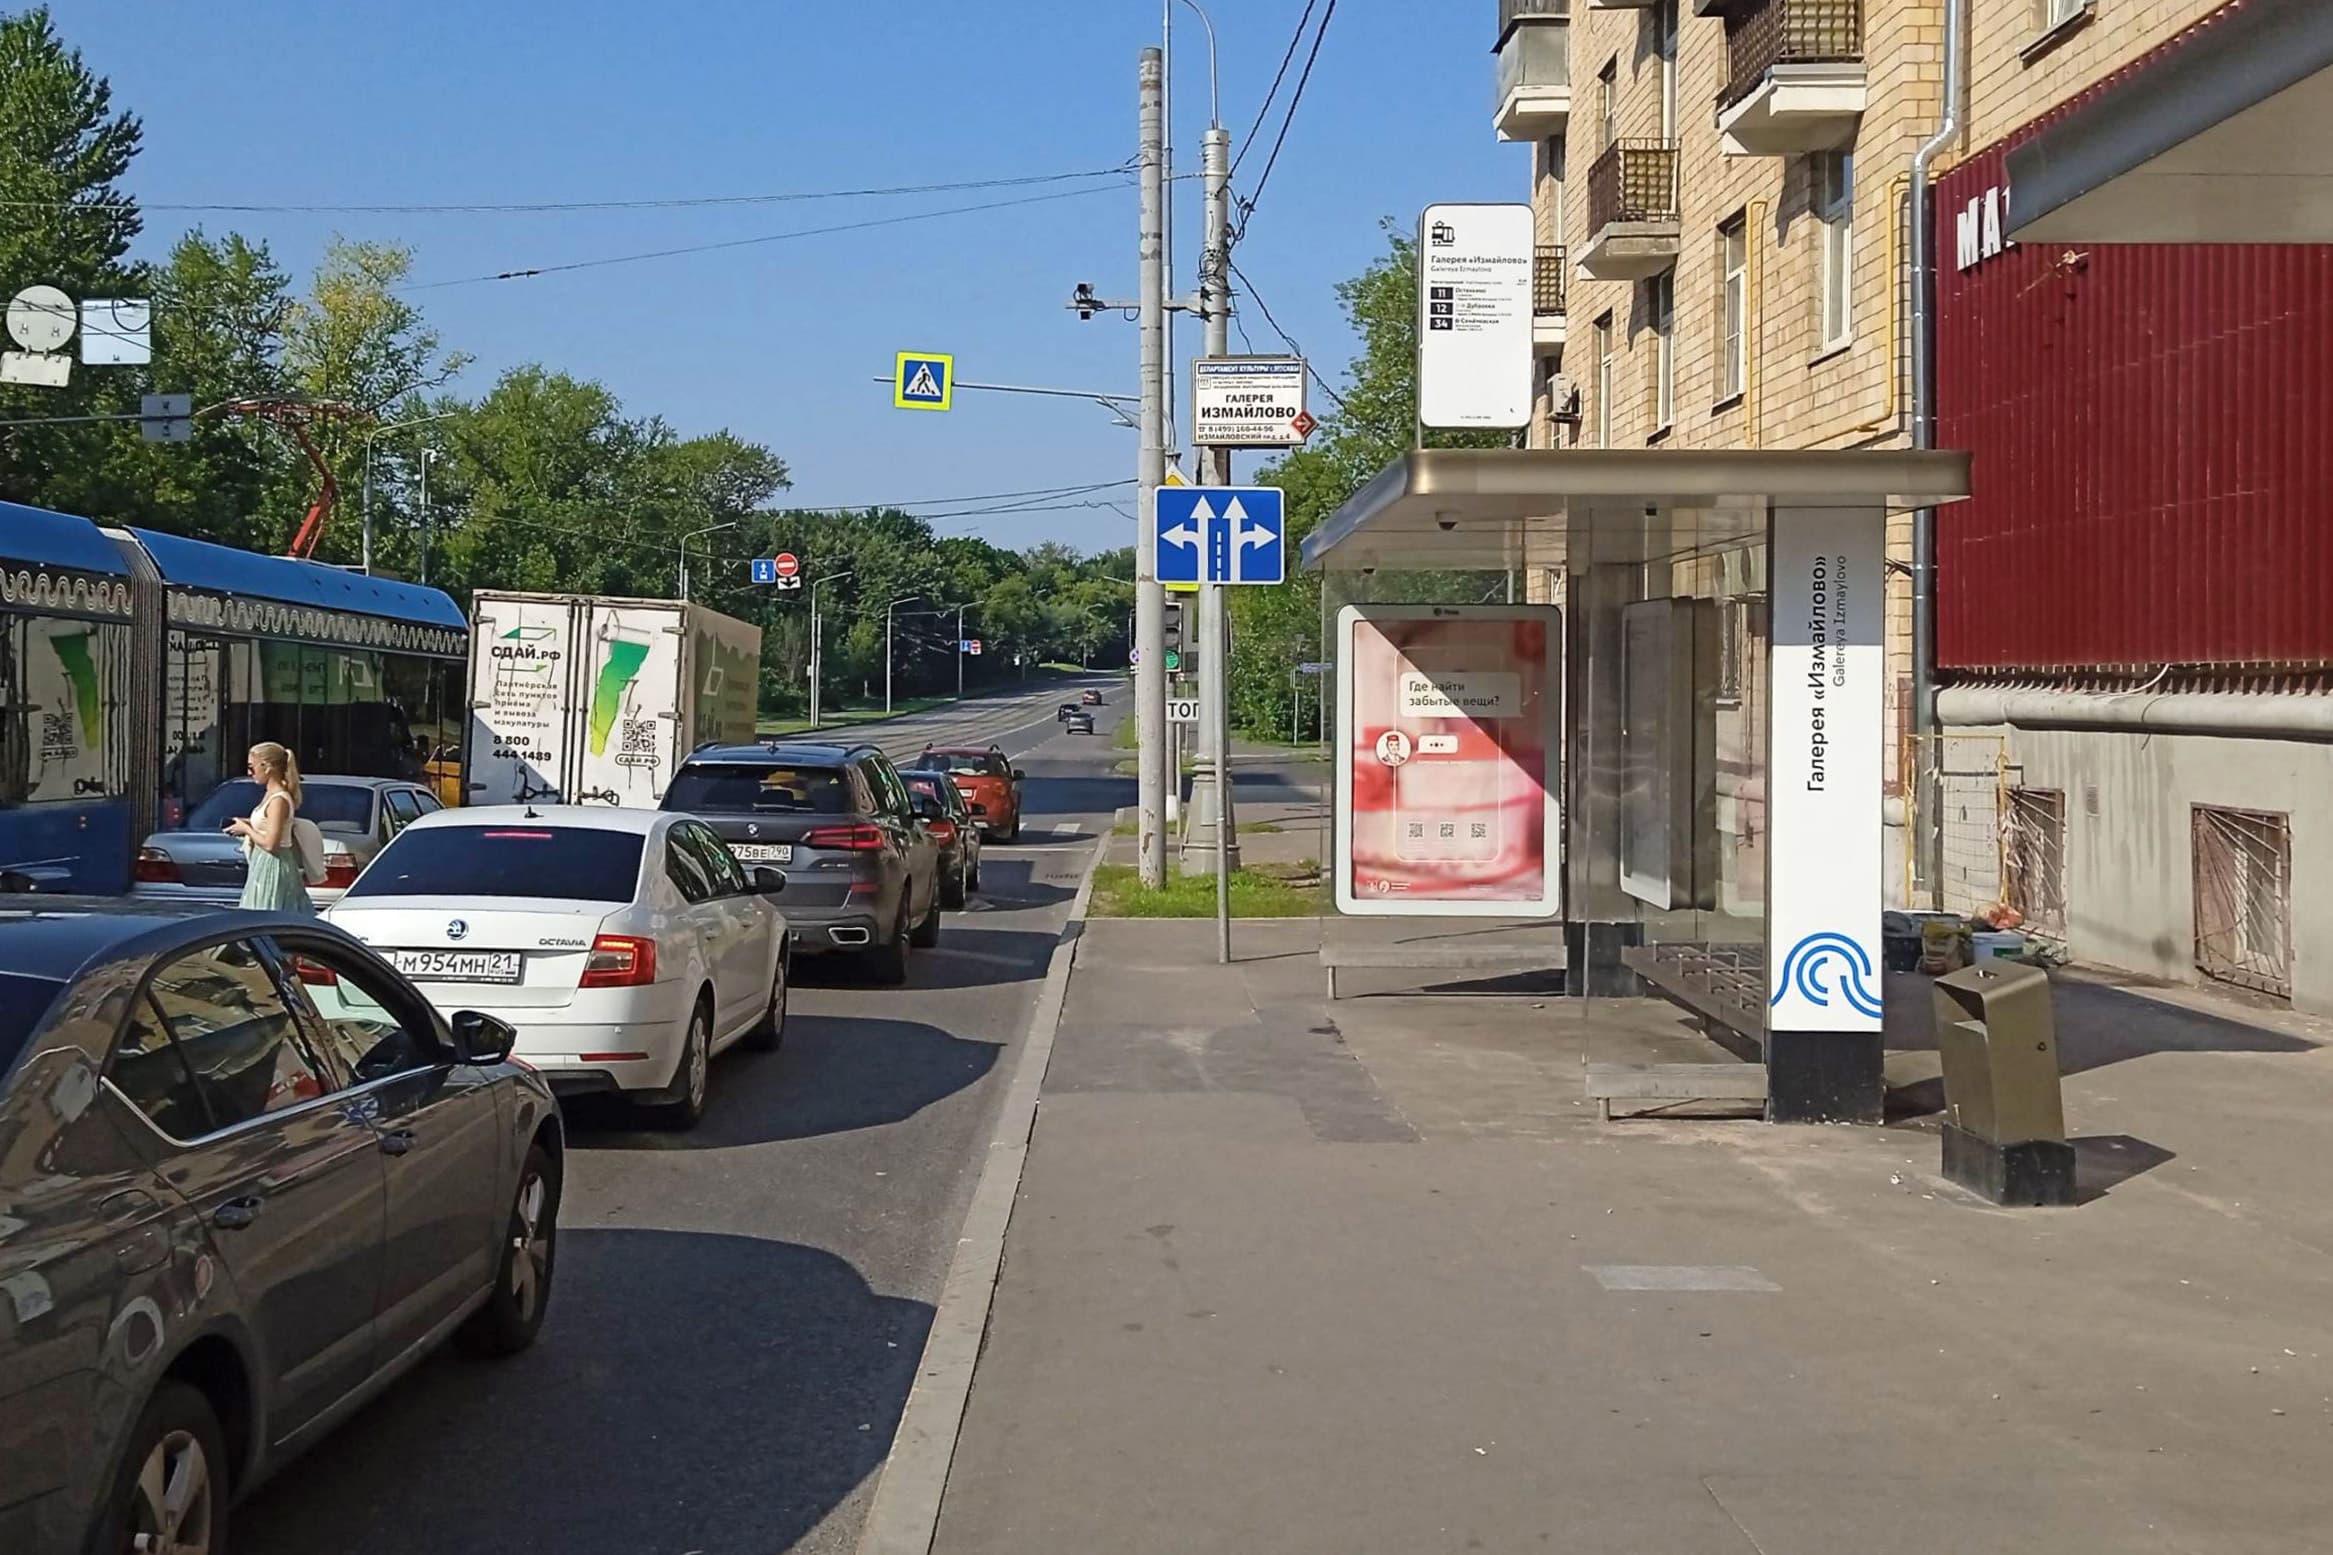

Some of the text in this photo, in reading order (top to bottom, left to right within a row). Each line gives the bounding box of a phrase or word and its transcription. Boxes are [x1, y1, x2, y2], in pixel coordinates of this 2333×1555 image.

[1431, 255, 1467, 264] Галерея
[1437, 289, 1446, 298] 11
[1436, 304, 1447, 313] 12
[1434, 319, 1448, 328] 34
[1225, 394, 1273, 403] ГАЛЕРЕЯ
[1201, 403, 1296, 418] ИЗМАЙЛОВО
[1832, 555, 1848, 687] Galereya Izmaylovo
[1807, 556, 1829, 791] Галерея «Измайлово»
[1409, 681, 1465, 692] Где найти
[1409, 695, 1500, 707] забытые вещи?
[494, 719, 550, 728] макулатуры
[493, 735, 530, 746] 8 800
[492, 749, 552, 761] 444 1489
[539, 938, 587, 947] OCTAVIA
[402, 953, 512, 974] М954МН 21
